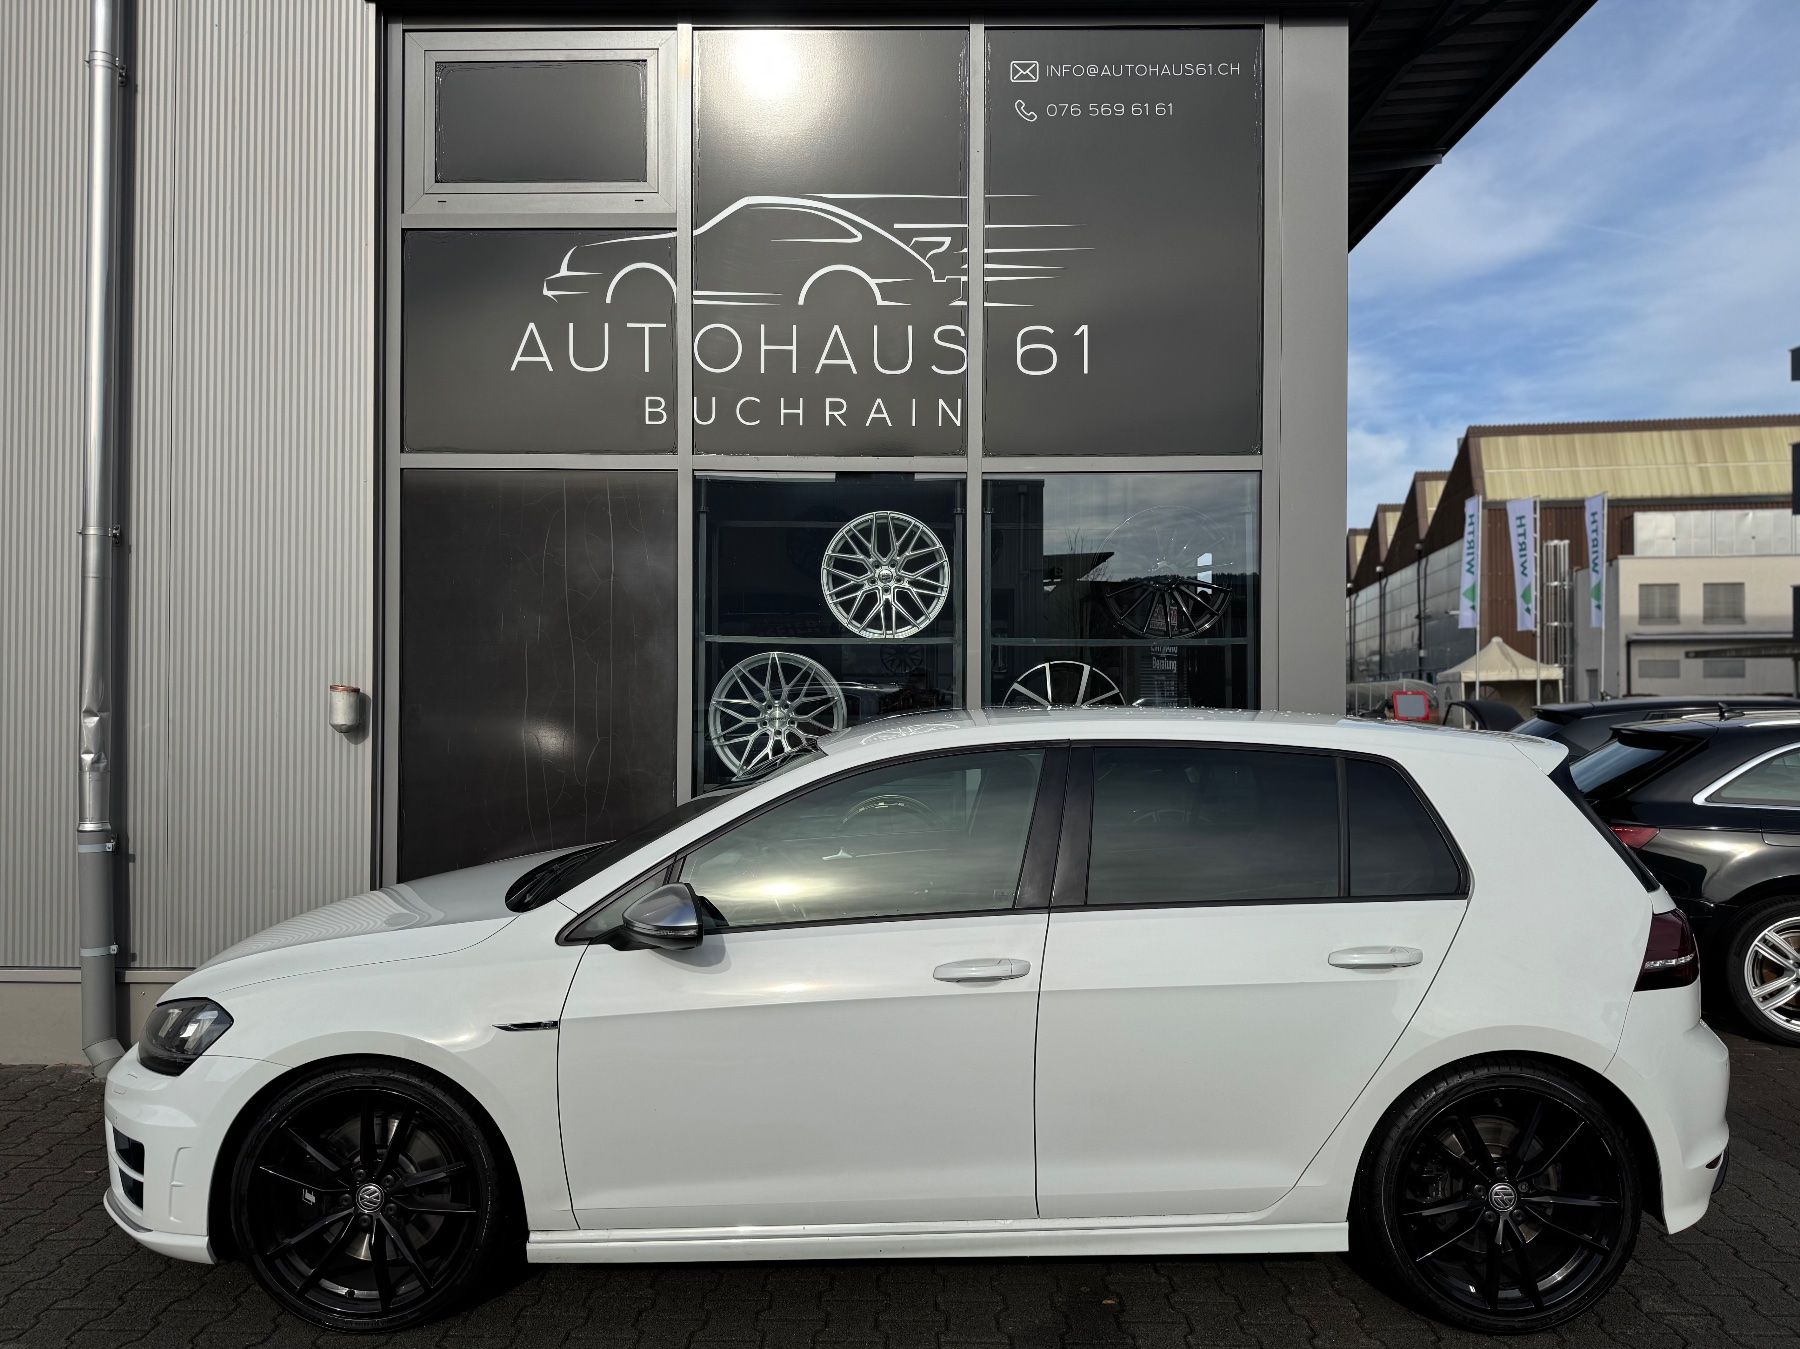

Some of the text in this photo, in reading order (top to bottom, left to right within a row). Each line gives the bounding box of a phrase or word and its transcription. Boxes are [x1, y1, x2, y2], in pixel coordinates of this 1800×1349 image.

[1046, 62, 1240, 77] INFO@AUTOHAUS61.CH
[1046, 102, 1173, 117] 076 569 61 61
[510, 322, 1090, 376] AUTOHAUS 61
[644, 396, 962, 427] BUCHRAIN
